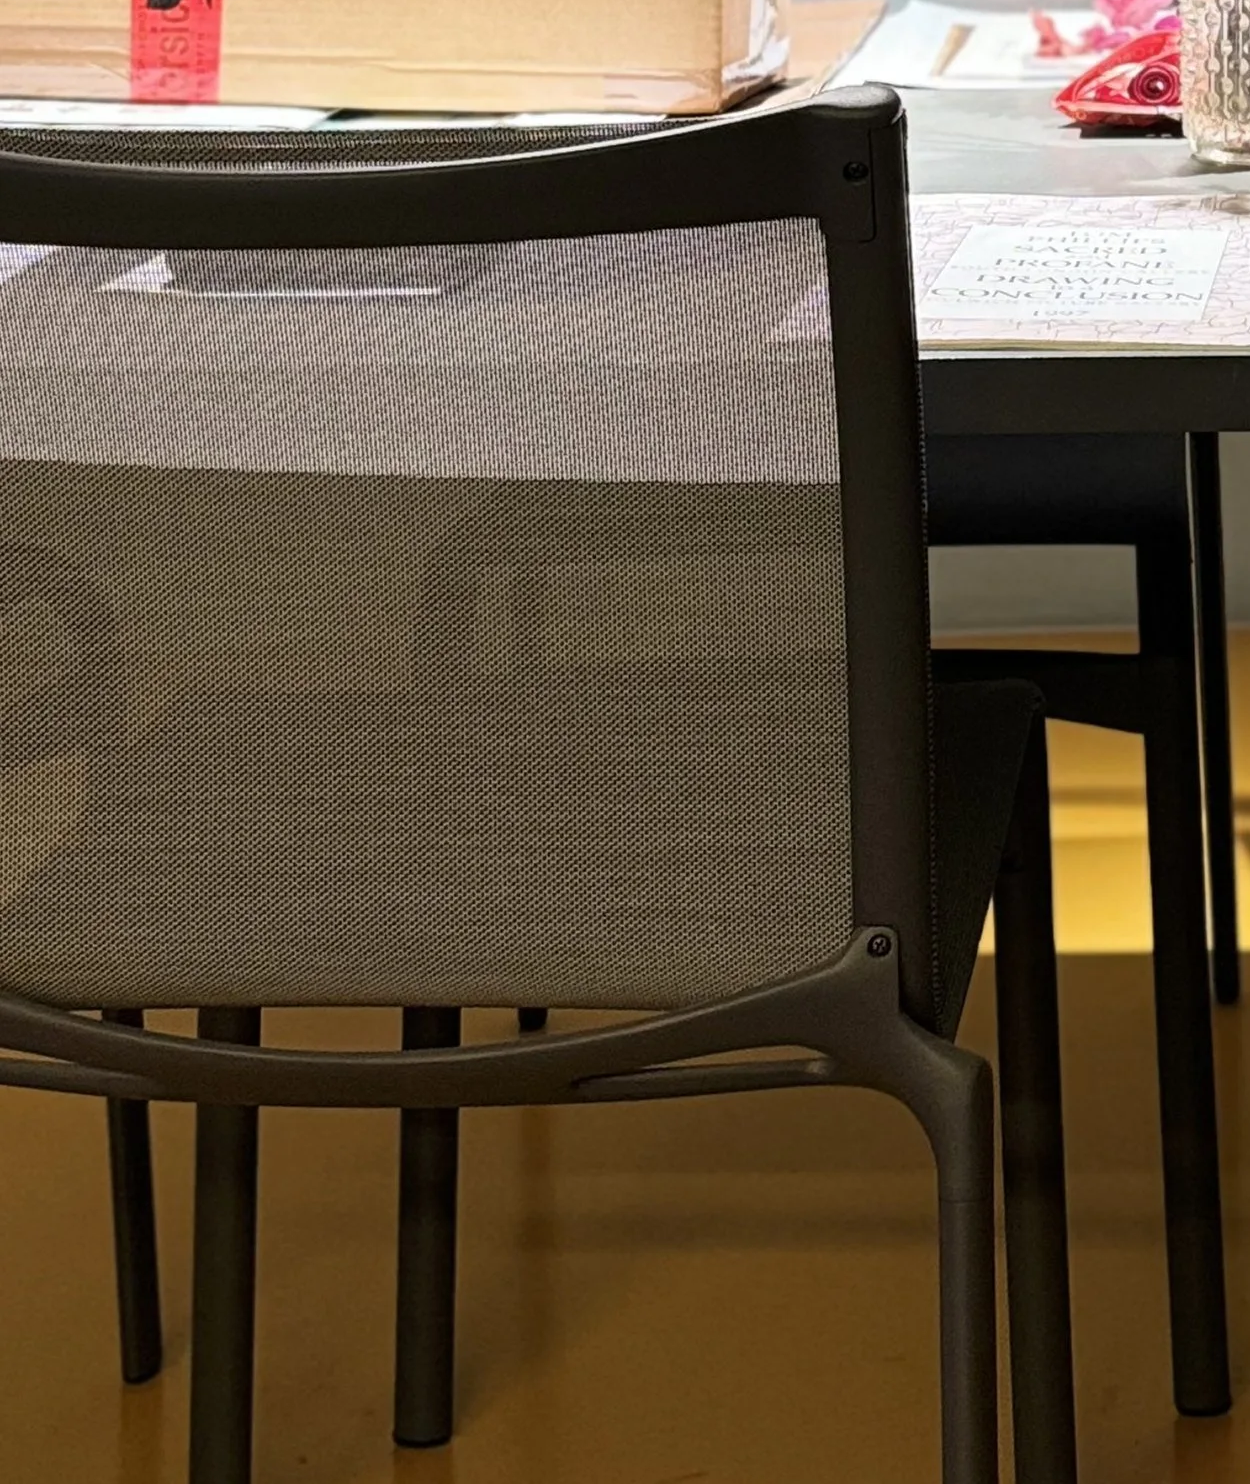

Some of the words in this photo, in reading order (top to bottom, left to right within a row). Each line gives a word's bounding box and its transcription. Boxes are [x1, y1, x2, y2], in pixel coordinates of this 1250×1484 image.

[1013, 245, 1168, 254] SACRED
[995, 258, 1175, 269] PROFANE
[976, 274, 1175, 285] DRAWING
[930, 288, 1204, 300] CONCLUSION
